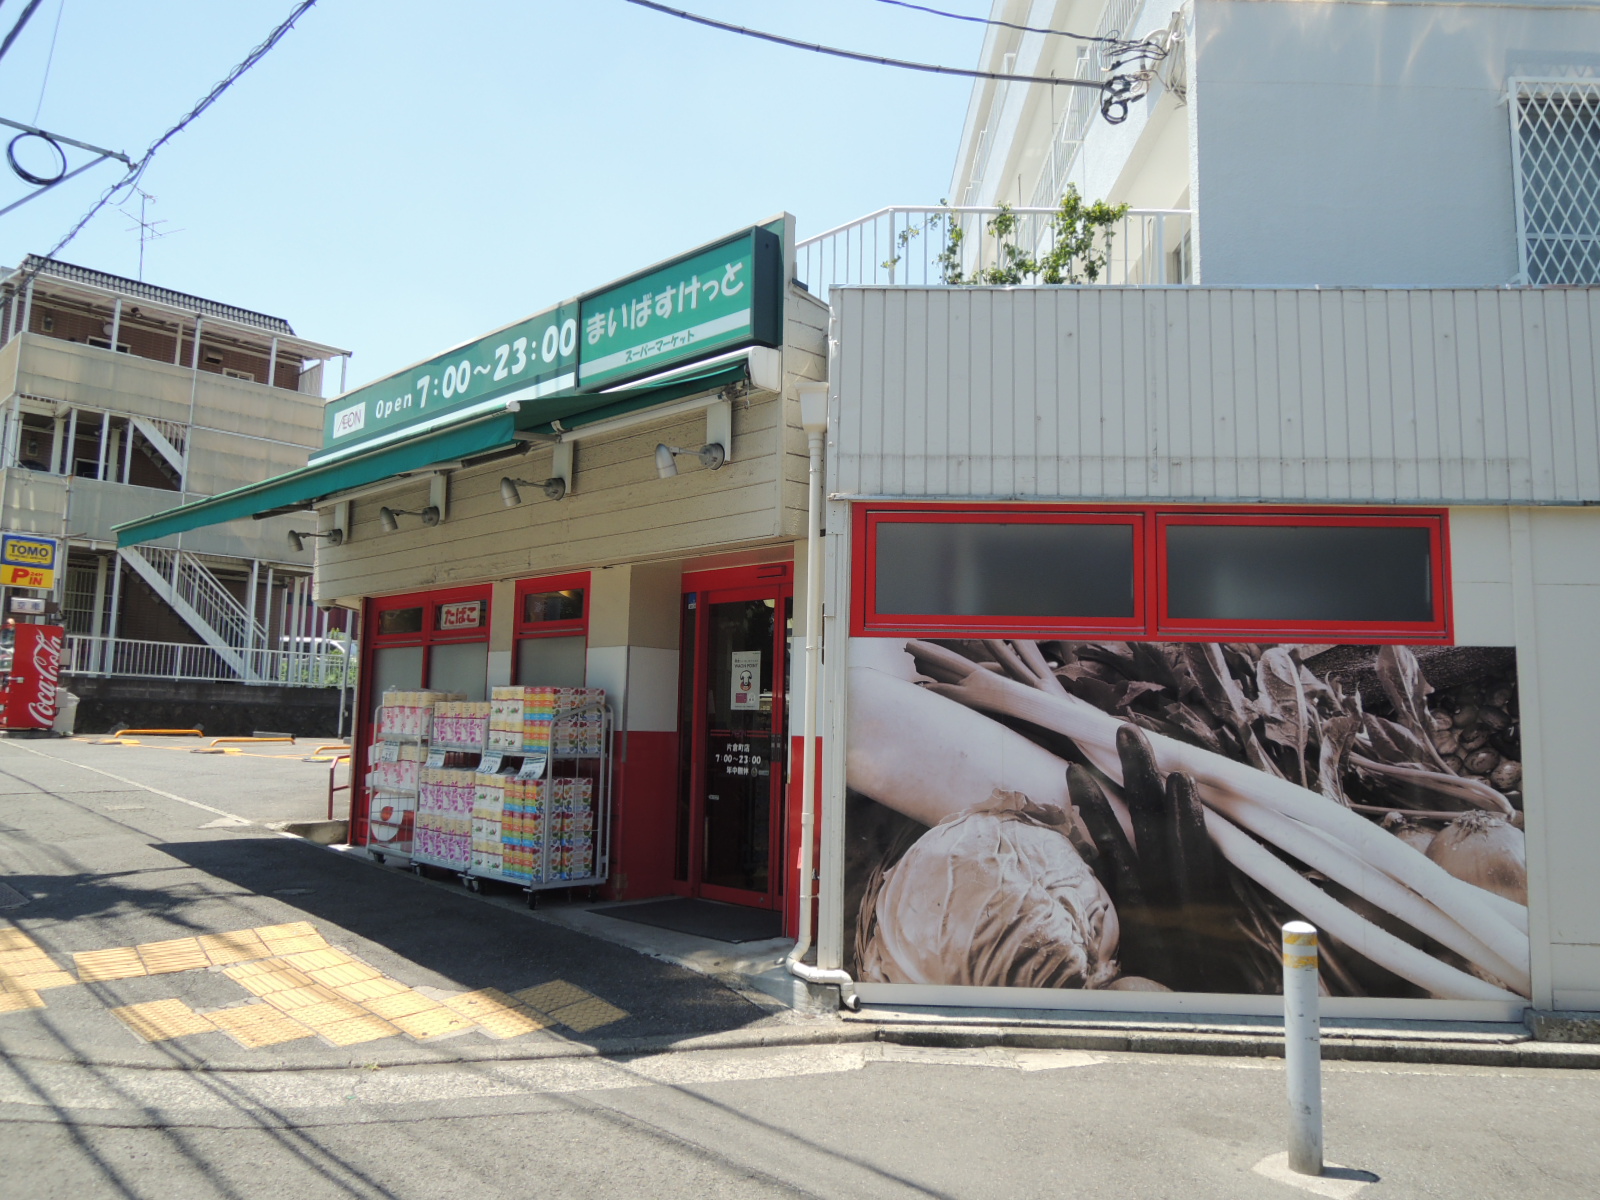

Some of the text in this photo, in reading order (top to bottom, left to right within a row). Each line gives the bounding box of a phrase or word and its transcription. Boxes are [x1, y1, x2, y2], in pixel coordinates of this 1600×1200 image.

[586, 262, 744, 345] まいばすけっと
[625, 330, 695, 362] スーパーマーケット
[375, 392, 412, 419] Open
[10, 544, 49, 557] TOMO
[10, 568, 30, 583] P
[29, 577, 43, 585] IN
[444, 606, 477, 625] たばこ
[28, 627, 61, 726] Coca-Cola
[726, 743, 750, 753] 片倉町店
